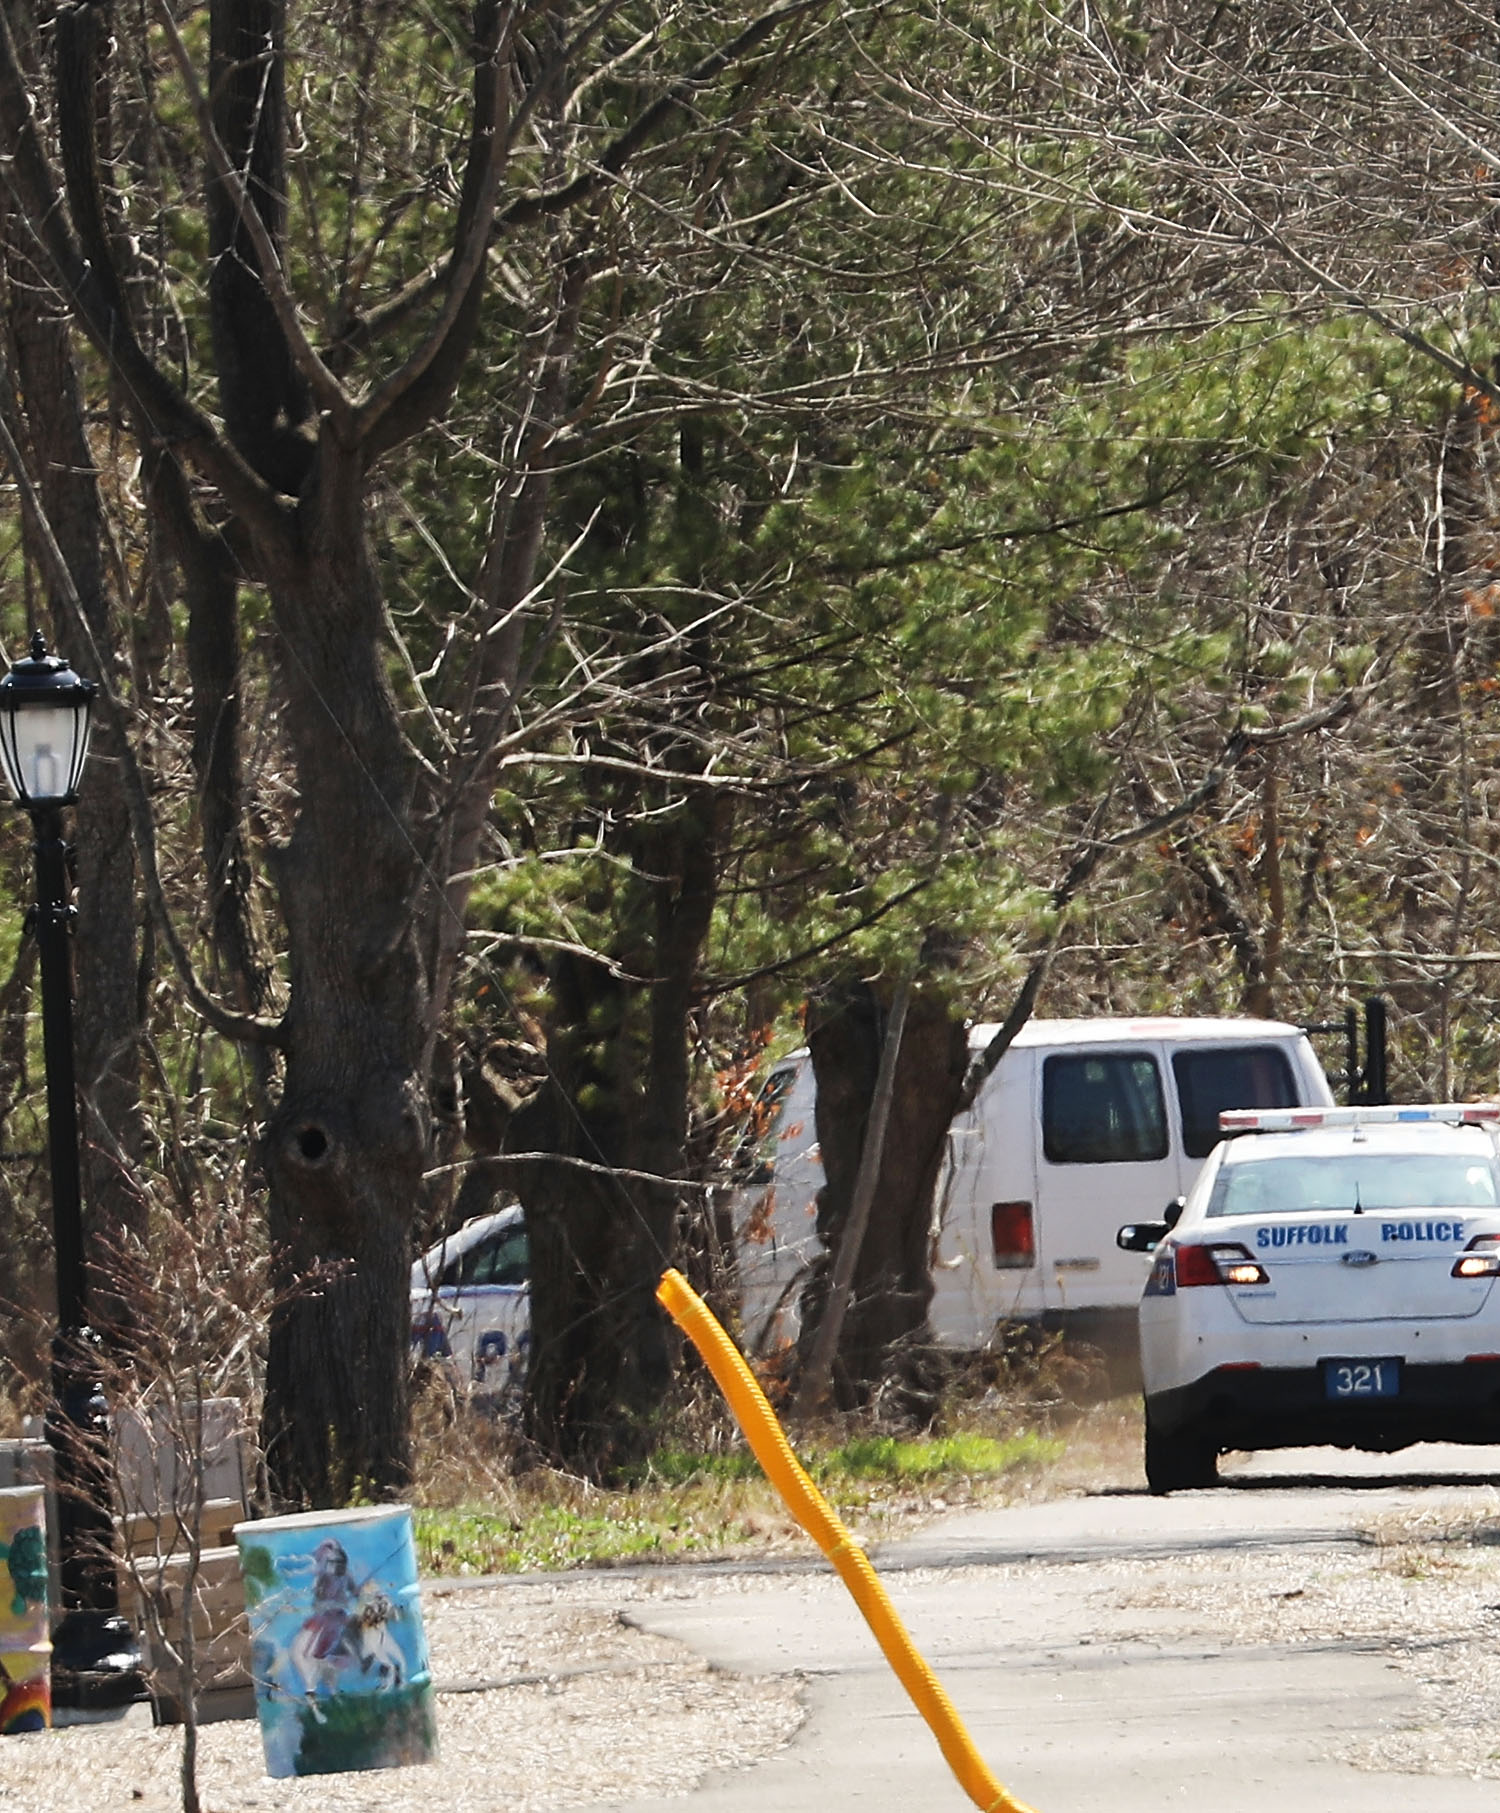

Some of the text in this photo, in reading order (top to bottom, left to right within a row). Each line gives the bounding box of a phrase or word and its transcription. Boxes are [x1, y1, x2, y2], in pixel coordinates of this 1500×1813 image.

[1257, 1222, 1465, 1248] SUFFOLK POLICE
[1336, 1364, 1382, 1393] 321
